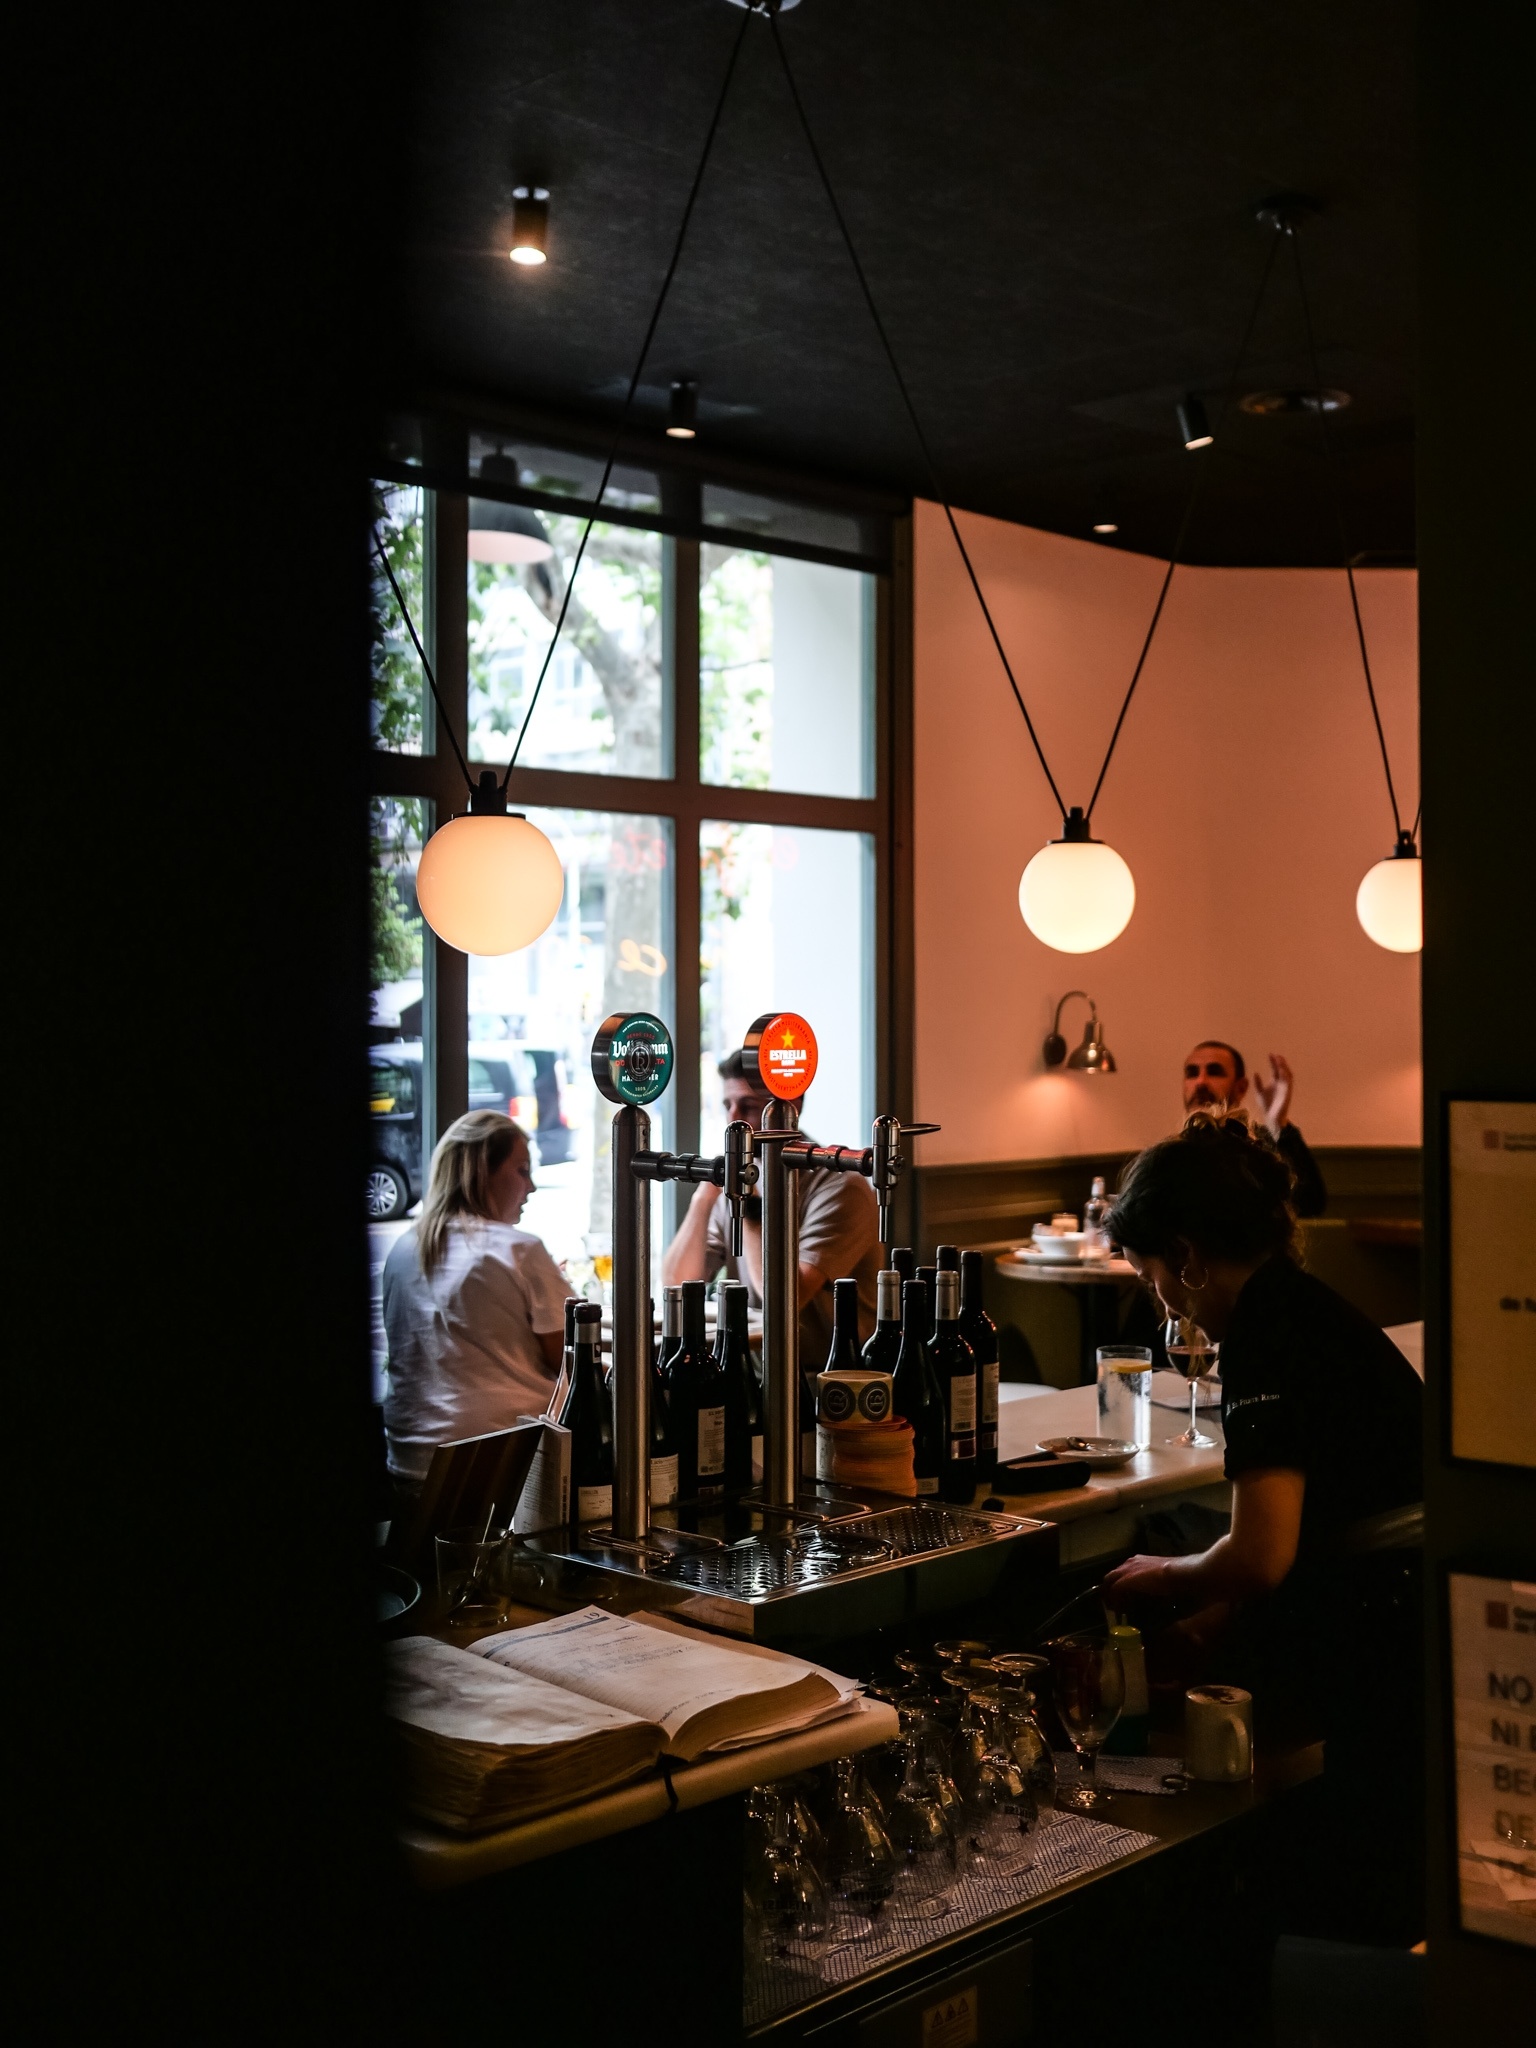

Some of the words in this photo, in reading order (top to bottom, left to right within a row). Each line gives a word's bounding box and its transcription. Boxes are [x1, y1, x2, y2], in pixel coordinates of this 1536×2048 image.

[769, 1050, 806, 1061] ESTRELLA
[1489, 1672, 1533, 1703] NO
[1493, 1764, 1536, 1796] BE
